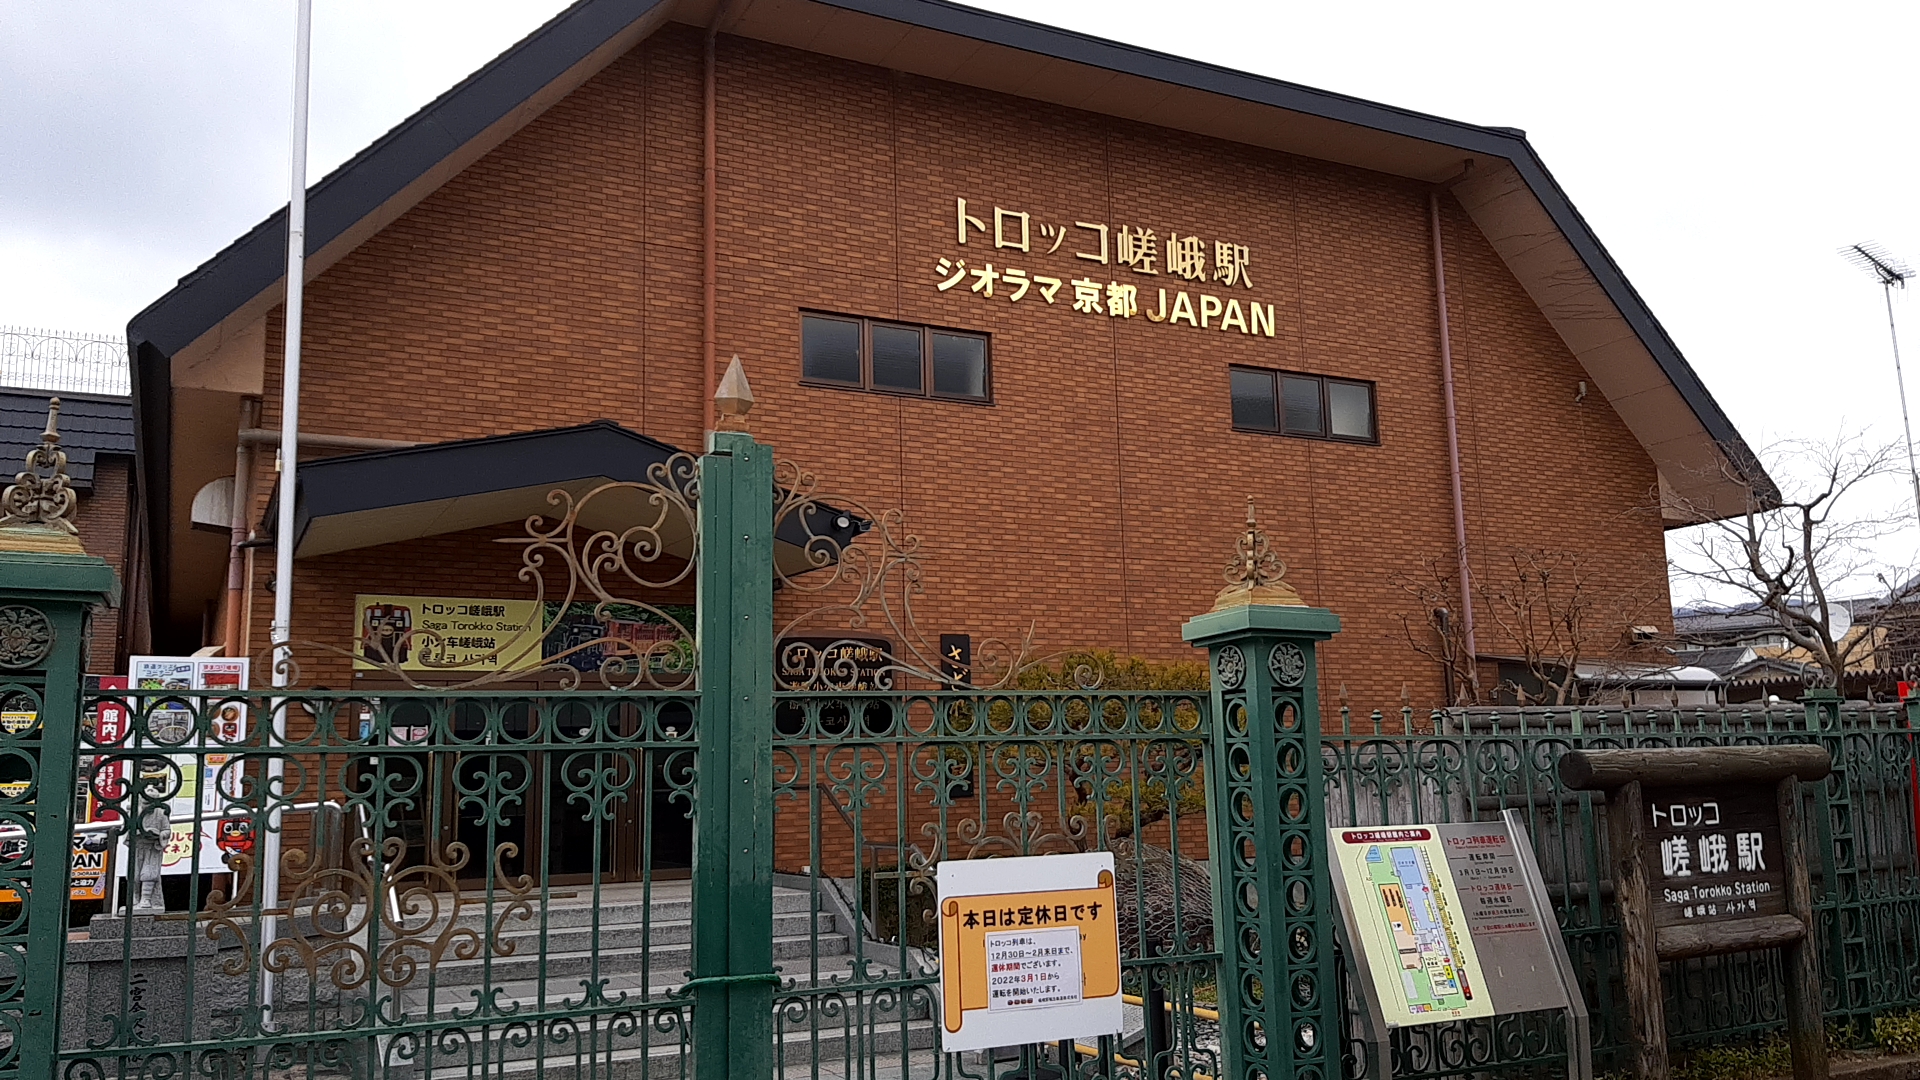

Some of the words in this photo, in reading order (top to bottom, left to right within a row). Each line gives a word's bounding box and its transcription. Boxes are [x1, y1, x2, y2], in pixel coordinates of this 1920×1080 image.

[957, 196, 1254, 289] トロッコ嵯峨駅
[1146, 288, 1275, 338] JAPAN
[421, 603, 505, 617] トロッコ嵯峨駅
[422, 620, 448, 631] Saga
[451, 620, 494, 631] Torokko
[496, 621, 532, 632] Station
[1652, 802, 1720, 828] トロッコ
[1660, 832, 1766, 877] 嵯峨駅
[1664, 887, 1690, 904] Saga
[1692, 884, 1732, 900] Torokko
[1735, 880, 1771, 896] Station
[963, 901, 1103, 930] 本日は定休日です
